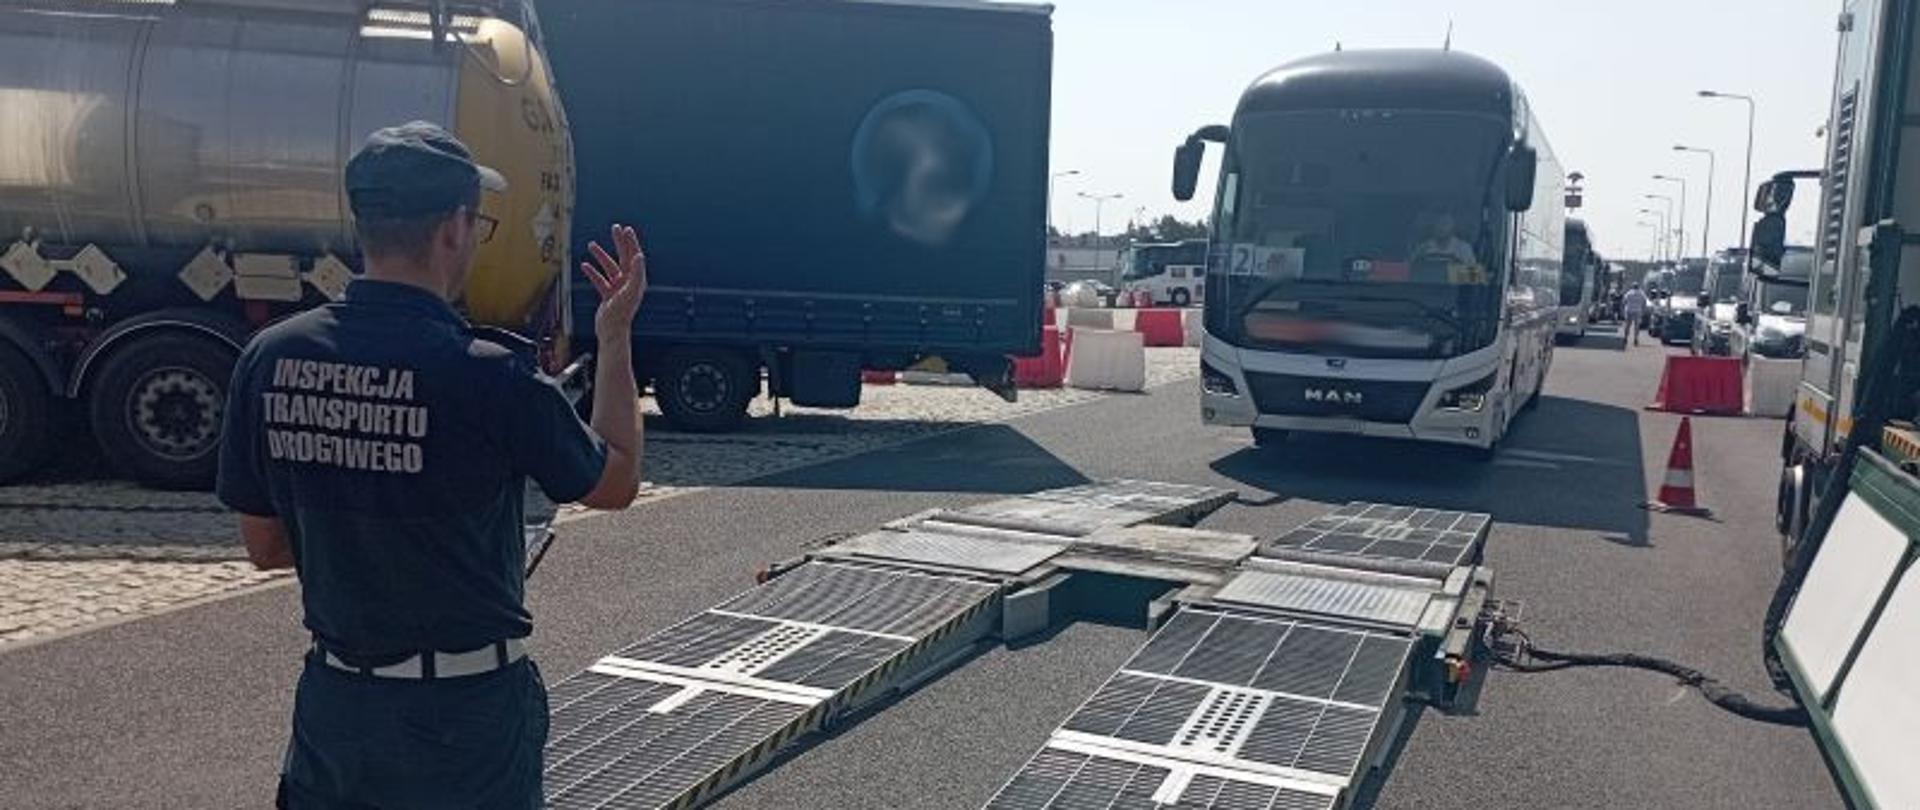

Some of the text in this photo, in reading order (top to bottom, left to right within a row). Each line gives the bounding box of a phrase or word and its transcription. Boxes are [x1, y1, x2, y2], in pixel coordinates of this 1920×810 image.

[1234, 247, 1249, 273] 2
[273, 358, 414, 400] INSPEKCJA
[1304, 388, 1362, 404] MAN
[262, 392, 428, 437] TRANSPORTU
[268, 429, 423, 473] DROGOWEGO
